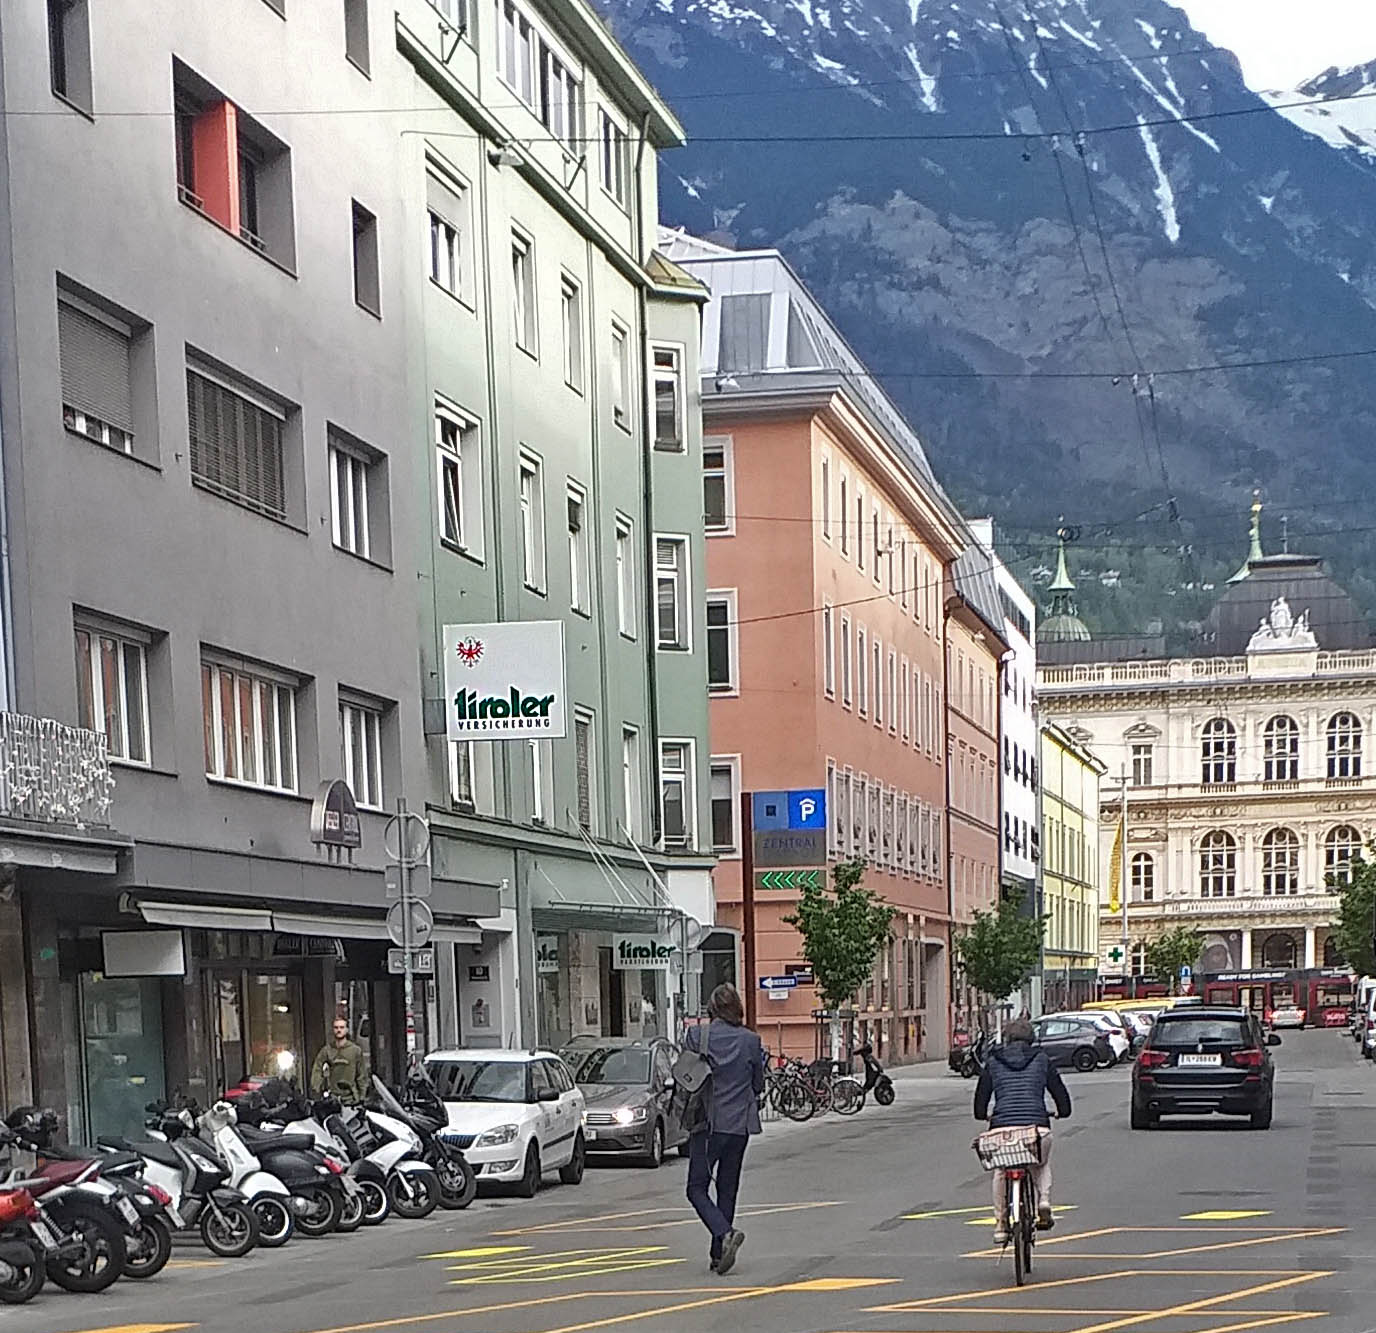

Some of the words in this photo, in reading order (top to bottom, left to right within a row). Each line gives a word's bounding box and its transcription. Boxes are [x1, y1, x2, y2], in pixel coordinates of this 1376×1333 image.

[454, 686, 555, 720] tiroler
[458, 719, 550, 730] VERSICHERUNG
[618, 939, 676, 959] tiroler
